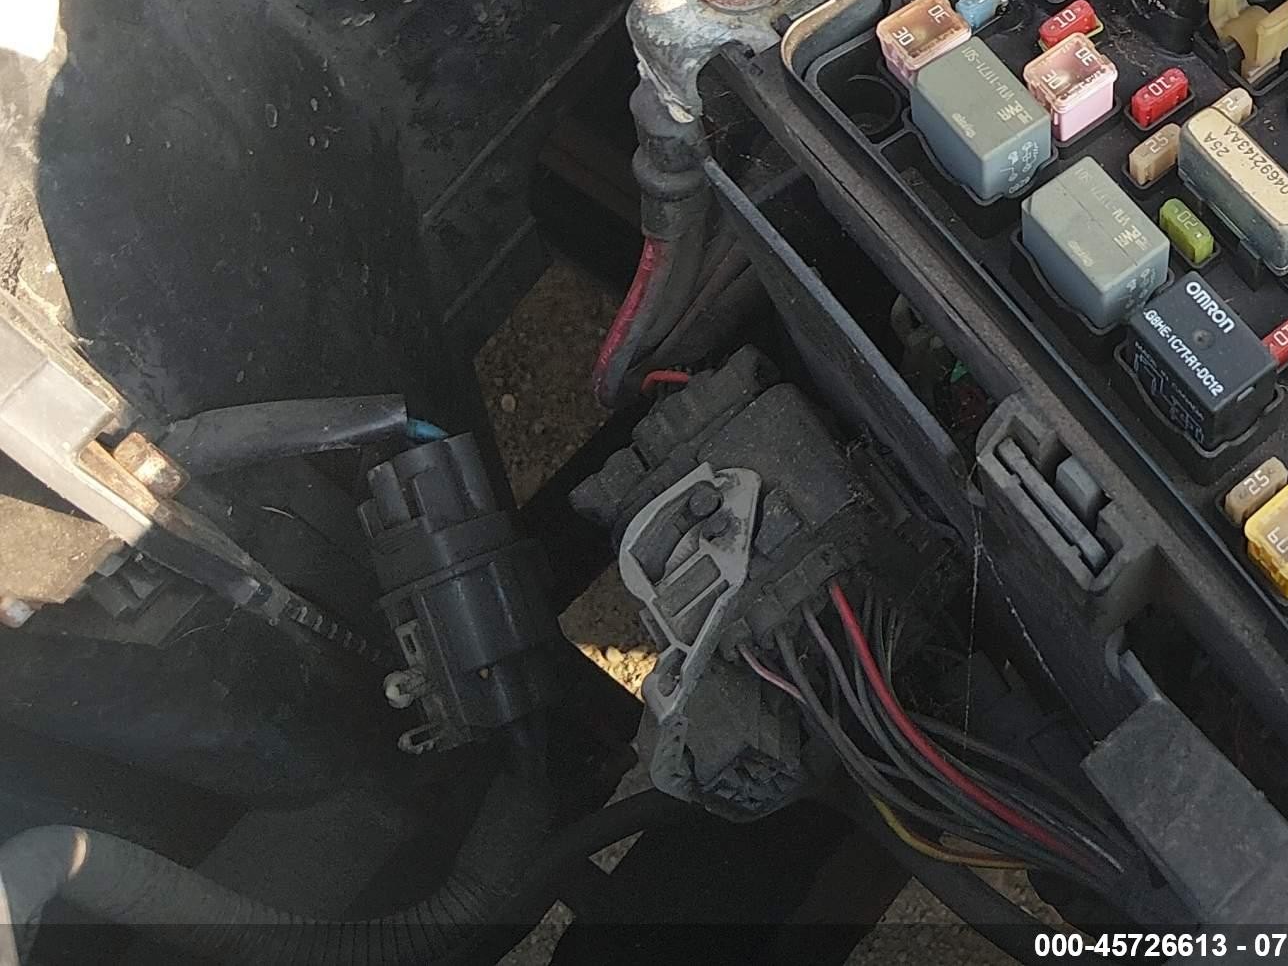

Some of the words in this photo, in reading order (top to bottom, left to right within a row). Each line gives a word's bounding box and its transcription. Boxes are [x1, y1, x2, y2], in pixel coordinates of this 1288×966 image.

[927, 4, 951, 24] 30
[1053, 8, 1077, 28] 10
[892, 26, 915, 46] 30
[1075, 46, 1097, 66] 30
[1041, 70, 1065, 90] 30
[1148, 76, 1171, 97] 10
[996, 100, 1025, 122] PWR
[1145, 132, 1169, 154] 25
[1203, 131, 1230, 158] 25A
[1176, 210, 1200, 230] 20
[1243, 469, 1270, 495] 25
